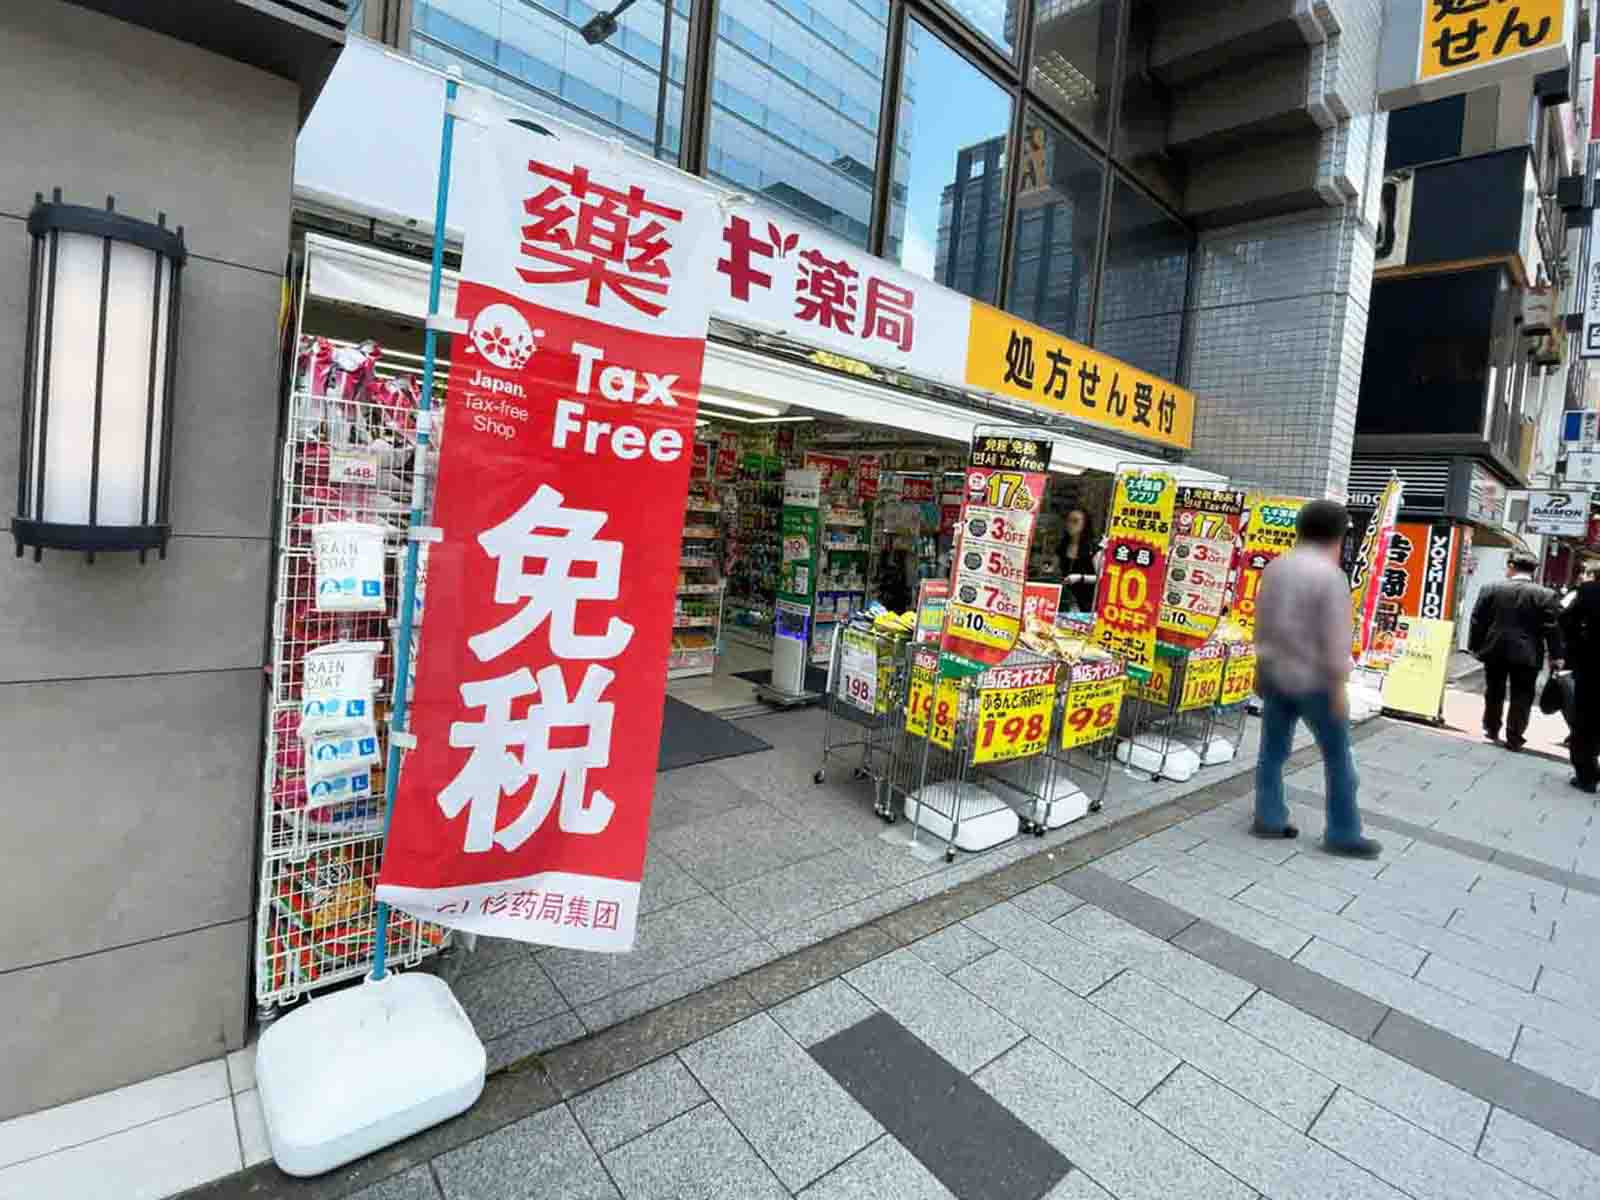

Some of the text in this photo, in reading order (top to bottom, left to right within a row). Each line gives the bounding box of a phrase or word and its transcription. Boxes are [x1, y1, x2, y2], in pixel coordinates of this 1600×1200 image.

[1432, 7, 1551, 66] せん
[515, 160, 682, 317] 藥
[571, 341, 680, 407] Tax
[1004, 330, 1176, 434] 処方せん受付
[464, 392, 528, 421] Tax-free
[473, 416, 516, 440] Shop
[552, 400, 683, 462] Free
[1000, 455, 1044, 471] Tax-free
[989, 473, 1024, 508] 17
[1533, 506, 1582, 518] DAIMON
[991, 518, 1004, 540] 3
[1193, 513, 1224, 537] 17
[319, 541, 360, 552] RAIN
[1004, 532, 1025, 542] OFF
[988, 552, 1002, 574] 5
[1117, 545, 1150, 565] 全品
[1194, 545, 1207, 560] 3
[318, 558, 356, 570] COAT
[1107, 565, 1147, 609] 10
[1190, 570, 1203, 585] 5
[1422, 537, 1448, 619] YOSHINO
[984, 586, 999, 607] 7
[1186, 594, 1200, 609] 7
[966, 612, 984, 632] 10
[1103, 607, 1147, 626] OFF
[1171, 612, 1186, 625] 10
[307, 661, 345, 674] RAIN
[437, 483, 635, 853] 免税
[305, 676, 343, 689] COAT
[846, 675, 869, 700] 198
[1068, 704, 1115, 732] 98
[981, 714, 1045, 749] 198
